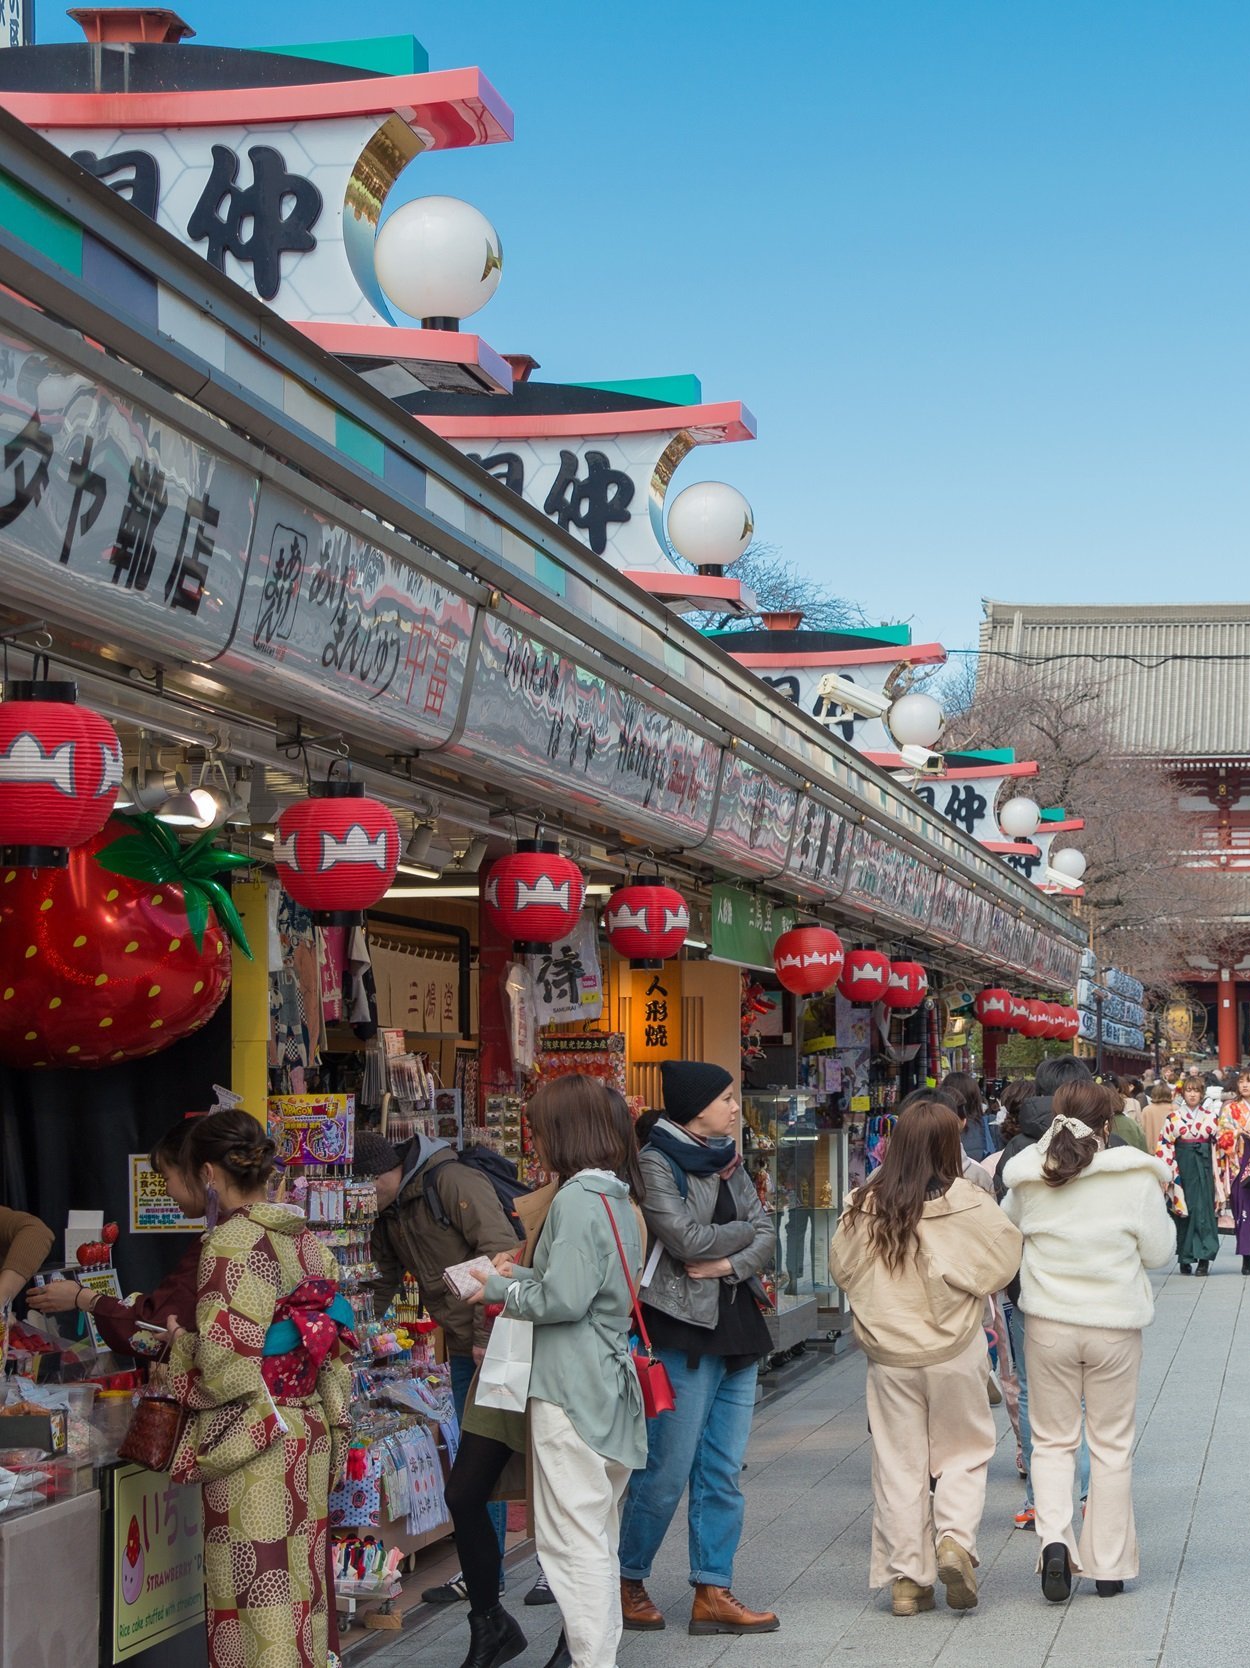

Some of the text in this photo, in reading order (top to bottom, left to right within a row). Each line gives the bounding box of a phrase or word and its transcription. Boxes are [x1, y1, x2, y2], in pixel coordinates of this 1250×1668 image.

[536, 944, 586, 1004] 侍
[553, 1005, 577, 1014] SAMURAI
[119, 1623, 131, 1638] Rice
[132, 1615, 144, 1634] cake
